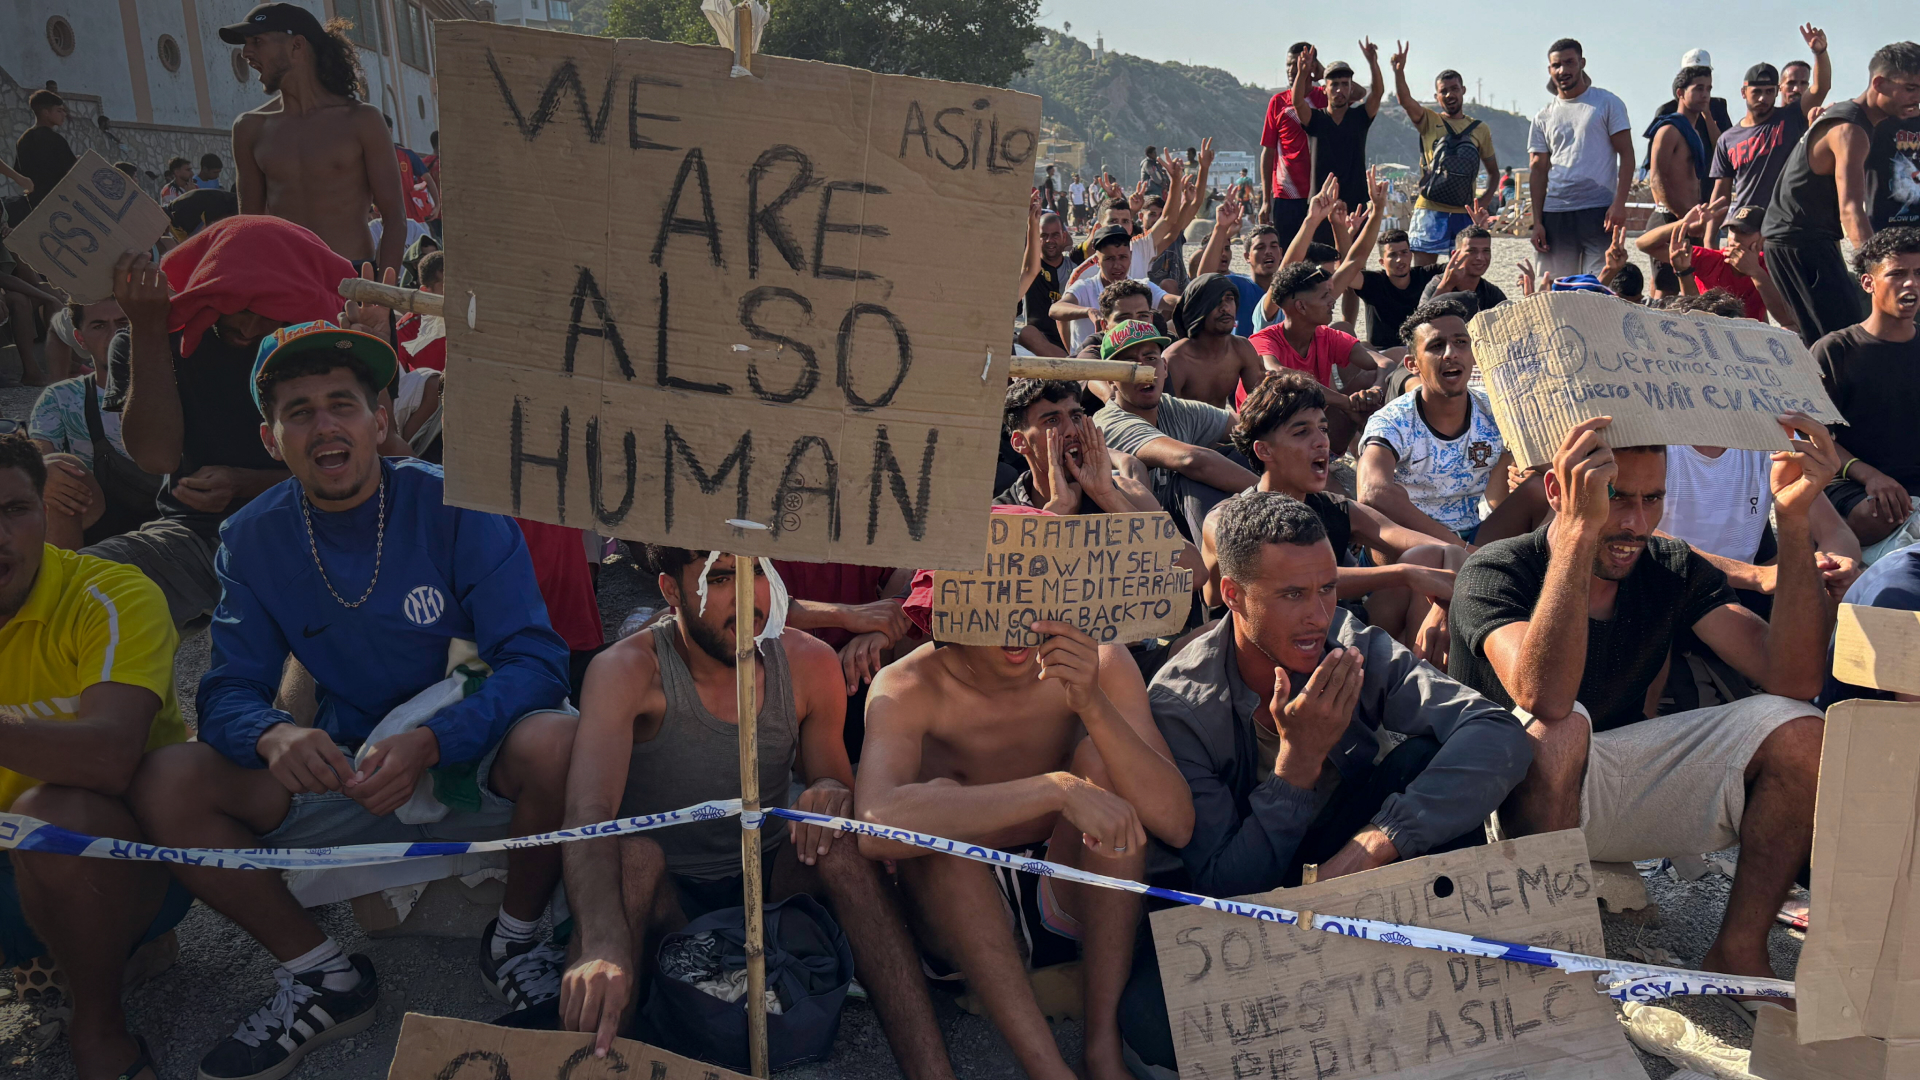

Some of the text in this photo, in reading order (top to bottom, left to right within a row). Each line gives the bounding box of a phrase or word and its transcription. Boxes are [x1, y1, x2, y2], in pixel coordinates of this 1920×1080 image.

[486, 47, 684, 150] WE
[650, 144, 892, 281] ARE
[562, 266, 913, 412] ALSO
[510, 396, 939, 546] HUMAN
[1020, 517, 1146, 548] RATHER
[1151, 516, 1176, 540] TO
[941, 571, 1193, 605] AT THE MEDITERRANE
[969, 552, 1081, 578] HROW
[934, 609, 1000, 634] THAN
[1005, 625, 1118, 647] MOCO
[1355, 862, 1592, 926] QUEREMOS
